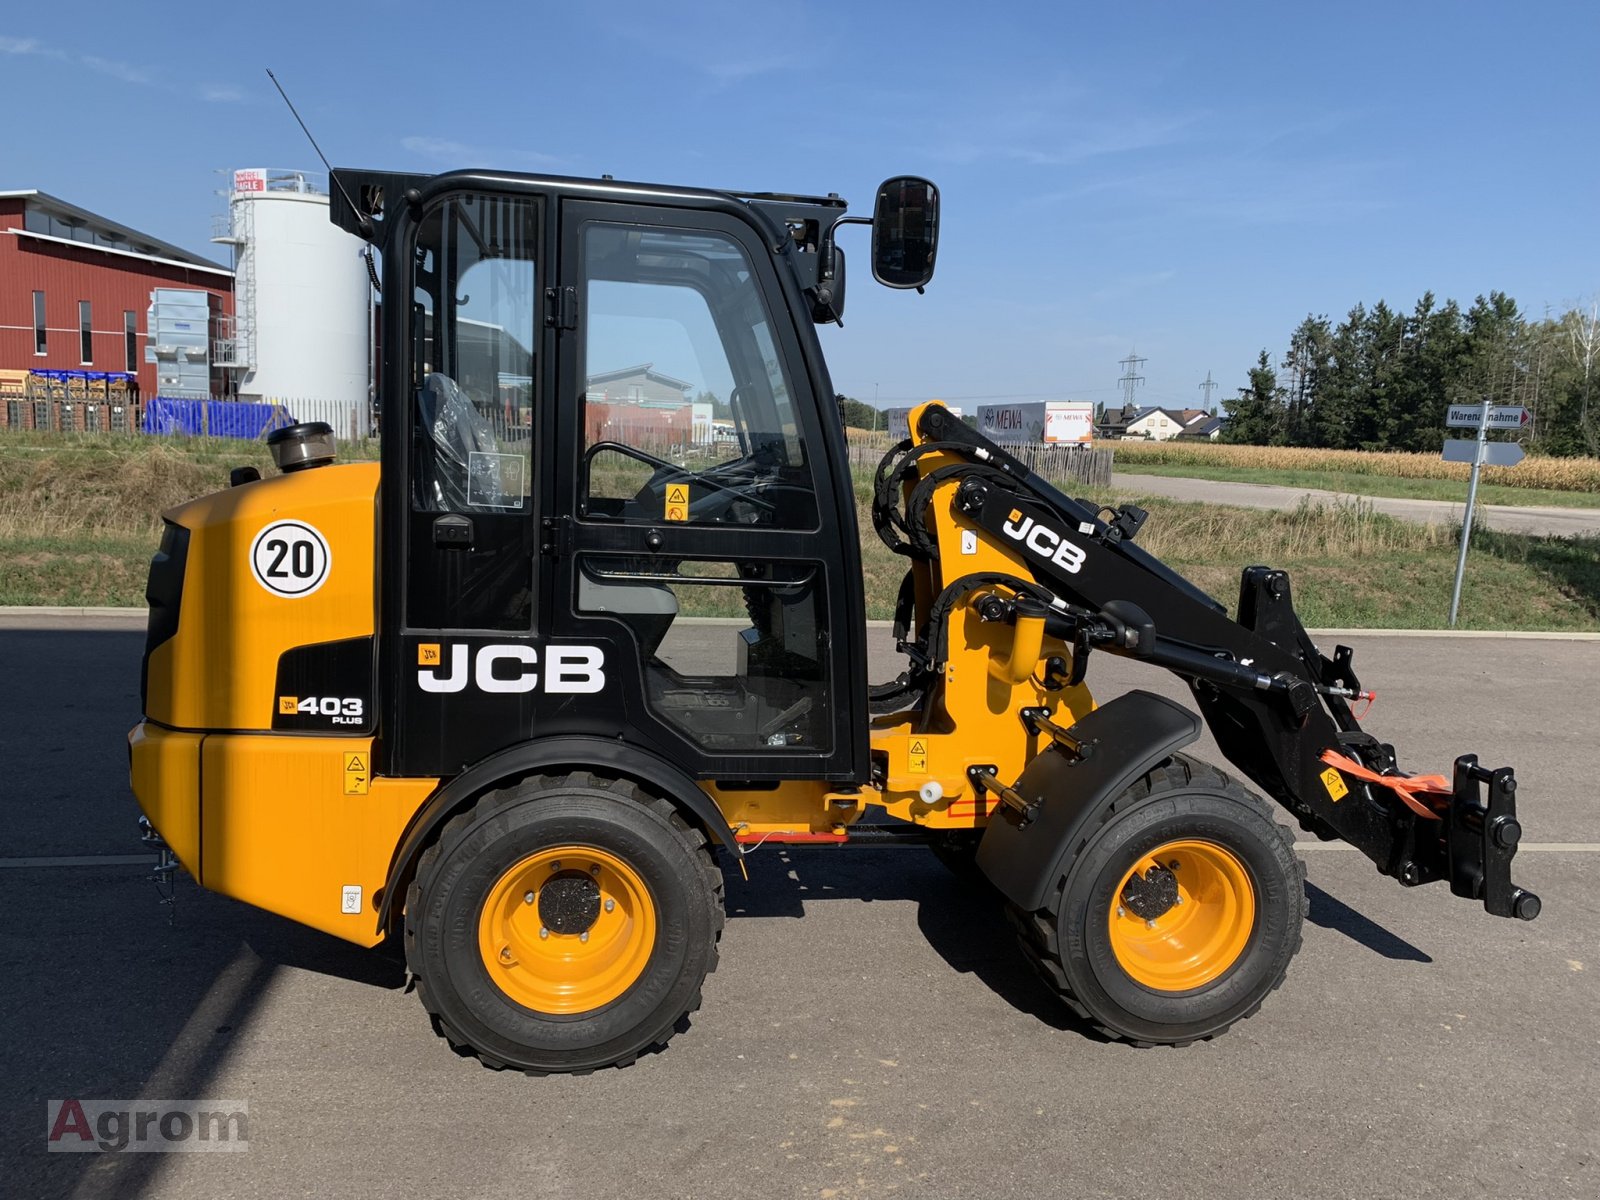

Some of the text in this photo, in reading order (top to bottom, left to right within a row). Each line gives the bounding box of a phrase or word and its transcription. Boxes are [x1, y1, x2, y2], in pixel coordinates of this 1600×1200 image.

[996, 409, 1022, 430] MEWA
[1451, 410, 1519, 422] Warenanahme
[266, 539, 314, 578] 20
[1002, 516, 1086, 574] JCB
[418, 644, 605, 693] JCB
[298, 697, 363, 715] 403
